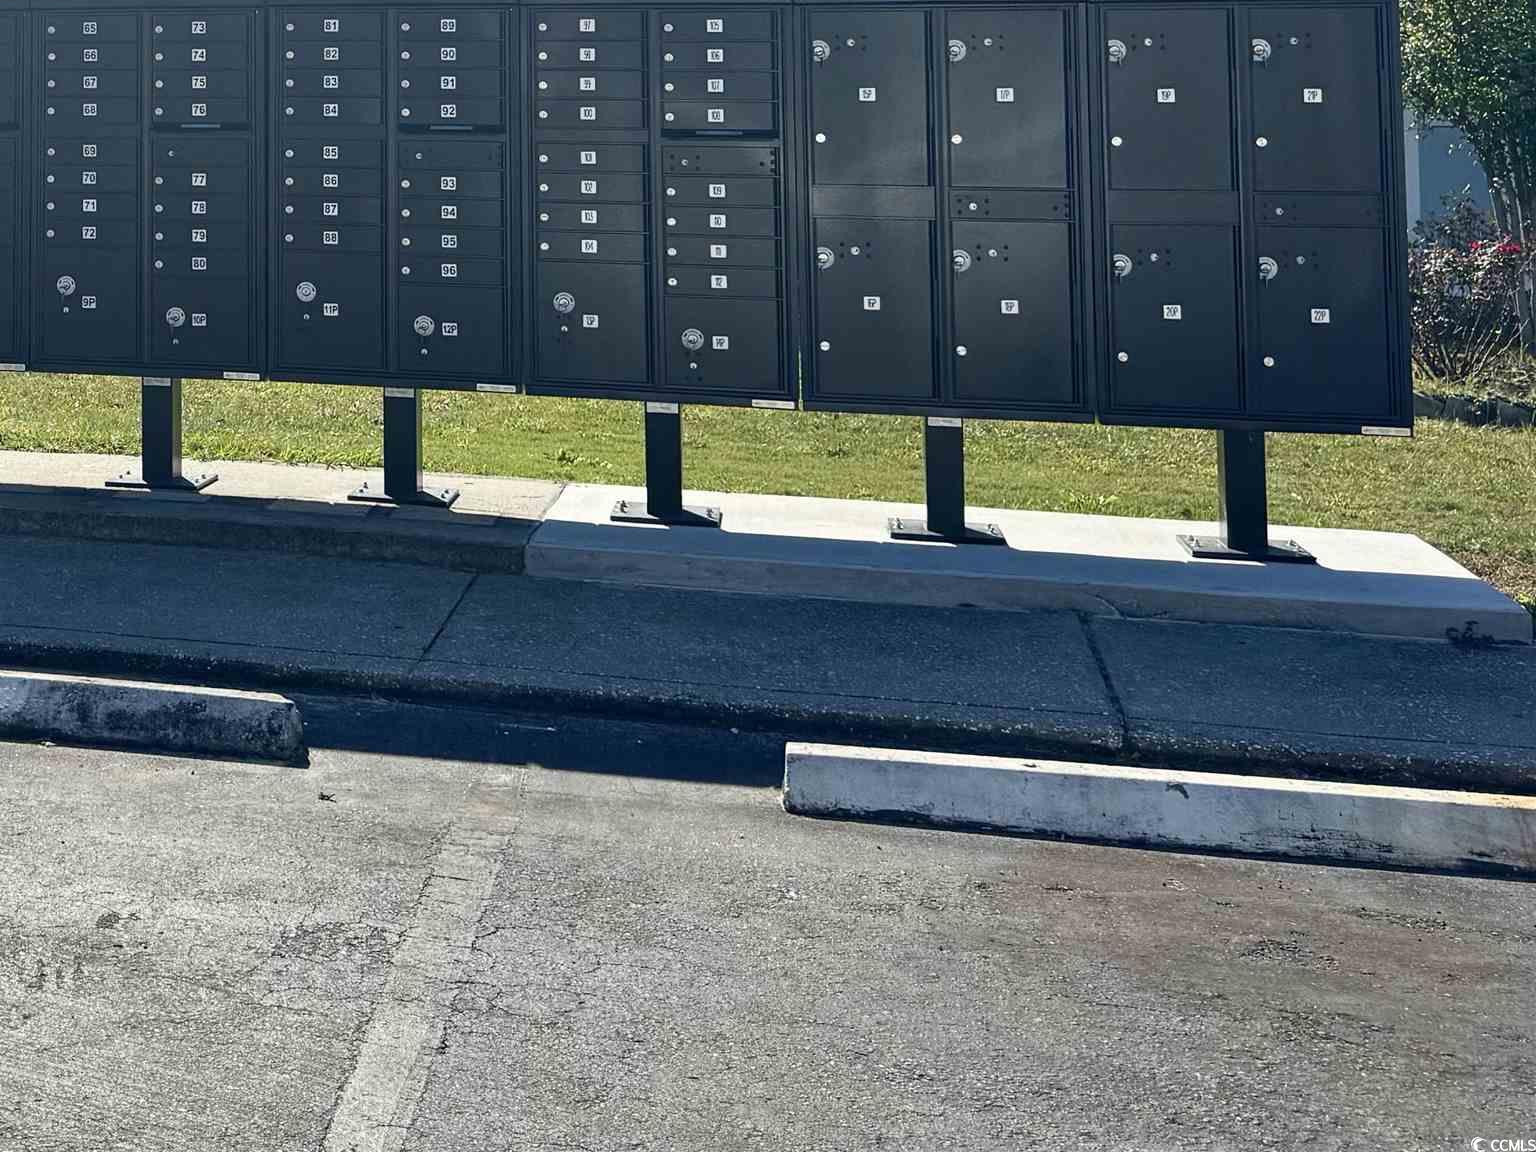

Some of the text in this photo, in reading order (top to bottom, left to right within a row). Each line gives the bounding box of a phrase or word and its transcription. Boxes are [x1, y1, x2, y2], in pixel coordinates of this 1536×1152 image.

[84, 23, 96, 33] 65
[193, 23, 205, 32] 73
[325, 21, 337, 31] 81
[442, 20, 455, 31] 89
[85, 50, 96, 60] 66
[193, 50, 205, 60] 74
[325, 49, 337, 59] 82
[442, 49, 455, 59] 90
[85, 77, 96, 87] 67
[193, 77, 205, 87] 75
[325, 77, 337, 87] 83
[442, 78, 455, 88] 91
[84, 105, 95, 115] 68
[193, 105, 205, 115] 76
[325, 105, 337, 115] 84
[442, 106, 455, 116] 92
[84, 146, 95, 156] 69
[324, 147, 337, 158] 85
[84, 173, 95, 183] 70
[193, 174, 205, 185] 77
[324, 175, 337, 186] 86
[442, 178, 455, 189] 93
[84, 200, 95, 210] 71
[193, 202, 205, 213] 78
[325, 204, 337, 214] 87
[442, 207, 455, 217] 94
[84, 228, 95, 238] 72
[193, 230, 205, 241] 79
[324, 233, 337, 243] 88
[443, 236, 456, 247] 95
[193, 258, 205, 269] 80
[442, 265, 456, 276] 96
[1165, 306, 1179, 318] 20P
[1313, 310, 1327, 322] 22P
